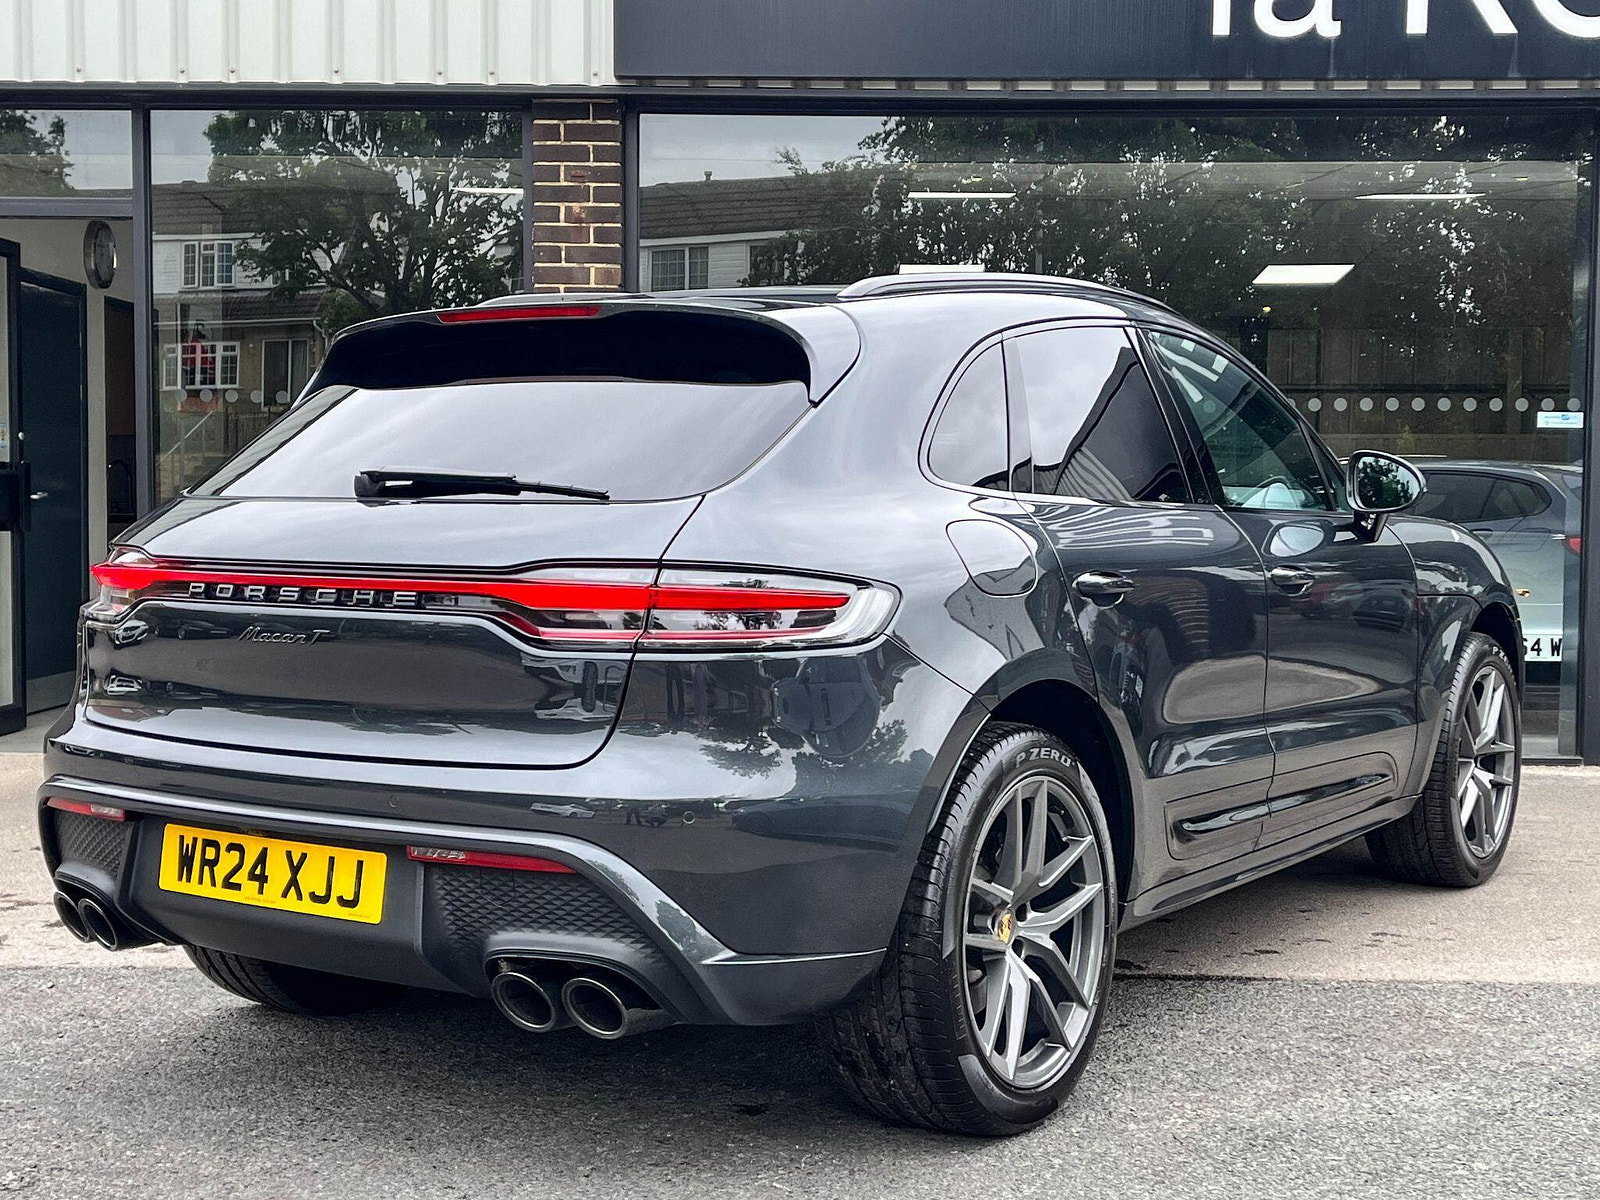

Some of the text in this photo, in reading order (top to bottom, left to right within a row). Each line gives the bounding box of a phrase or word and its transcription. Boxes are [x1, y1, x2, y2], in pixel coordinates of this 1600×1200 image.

[188, 582, 418, 607] PORSCHE
[237, 625, 331, 644] Macan T
[1015, 747, 1073, 768] P ZERO
[177, 834, 364, 909] WR24 XJJ
